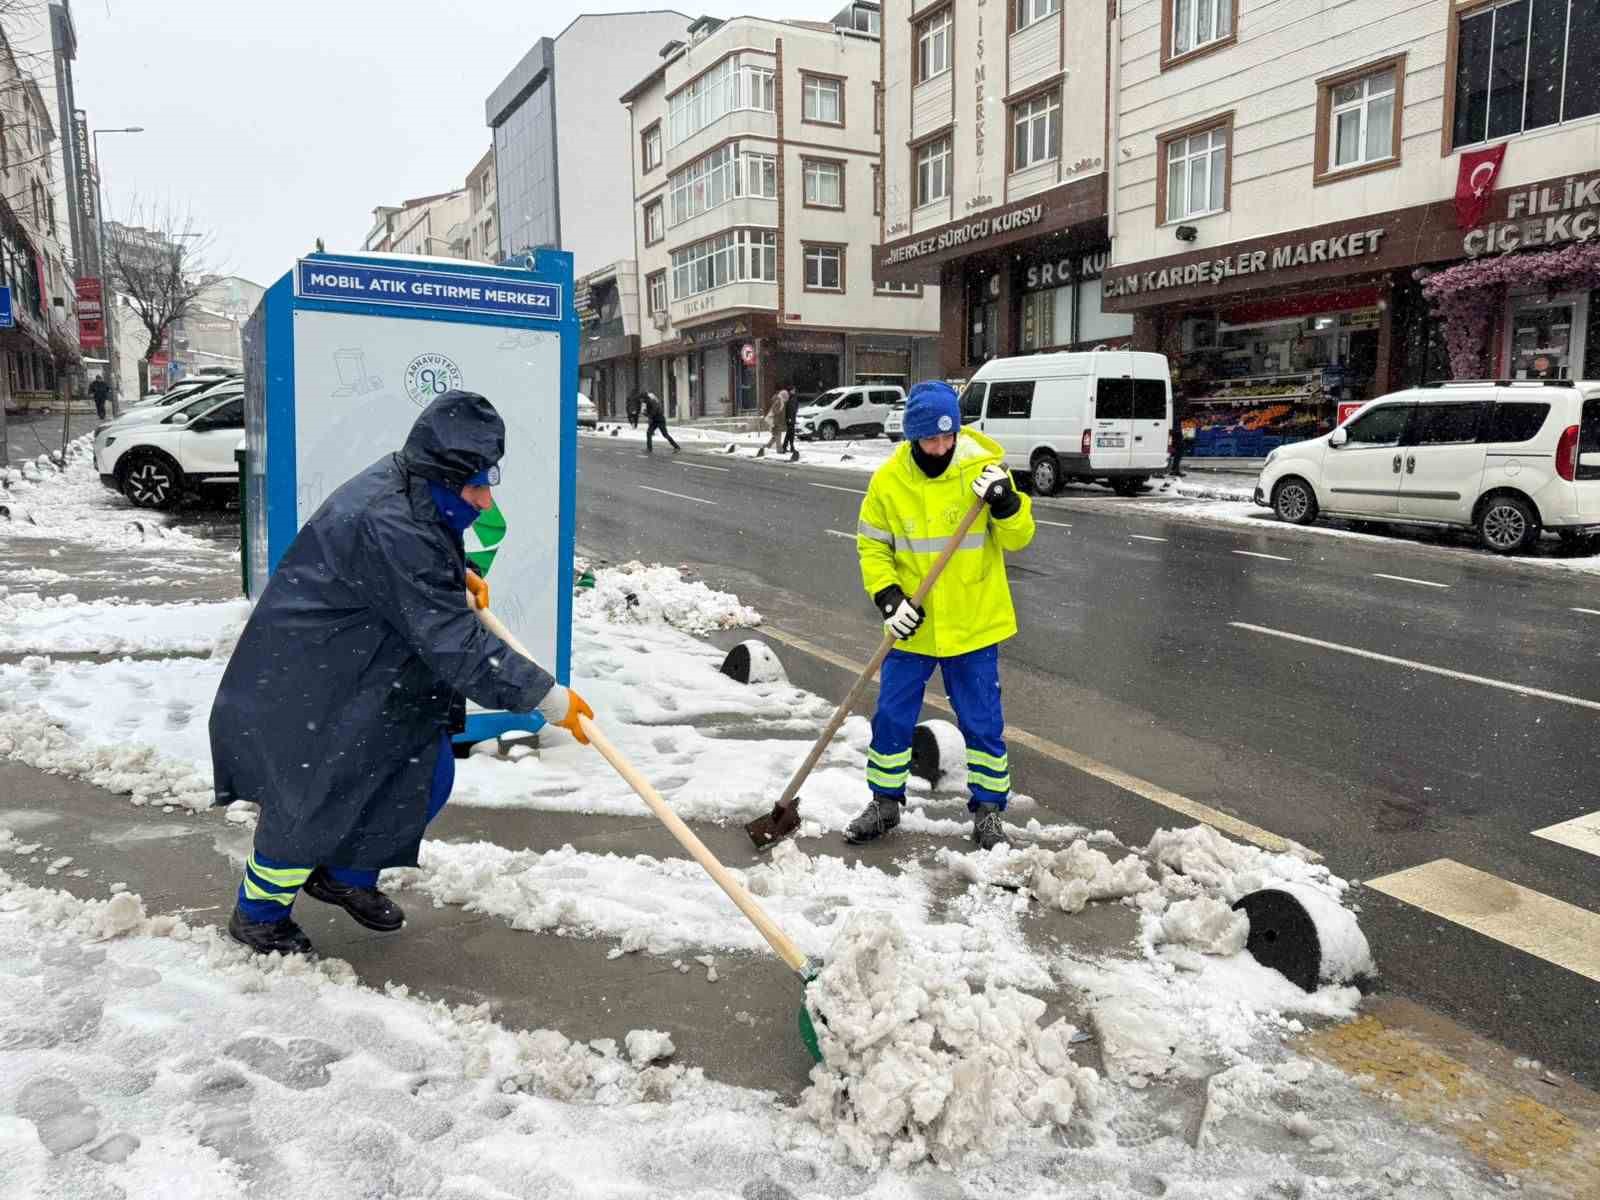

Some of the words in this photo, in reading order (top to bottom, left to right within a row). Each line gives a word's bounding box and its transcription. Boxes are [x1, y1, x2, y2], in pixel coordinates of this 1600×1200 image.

[889, 235, 937, 263] MERKEZ
[991, 204, 1041, 234] KURSU
[1463, 210, 1600, 259] ÇİÇEKÇ
[310, 273, 365, 289] MOBİL
[369, 278, 407, 293] ATIK
[1027, 259, 1070, 288] SRC
[1082, 251, 1112, 276] KU
[1103, 275, 1138, 298] CAN
[1141, 250, 1267, 292] KARDEŞLER
[1271, 228, 1384, 269] MARKET
